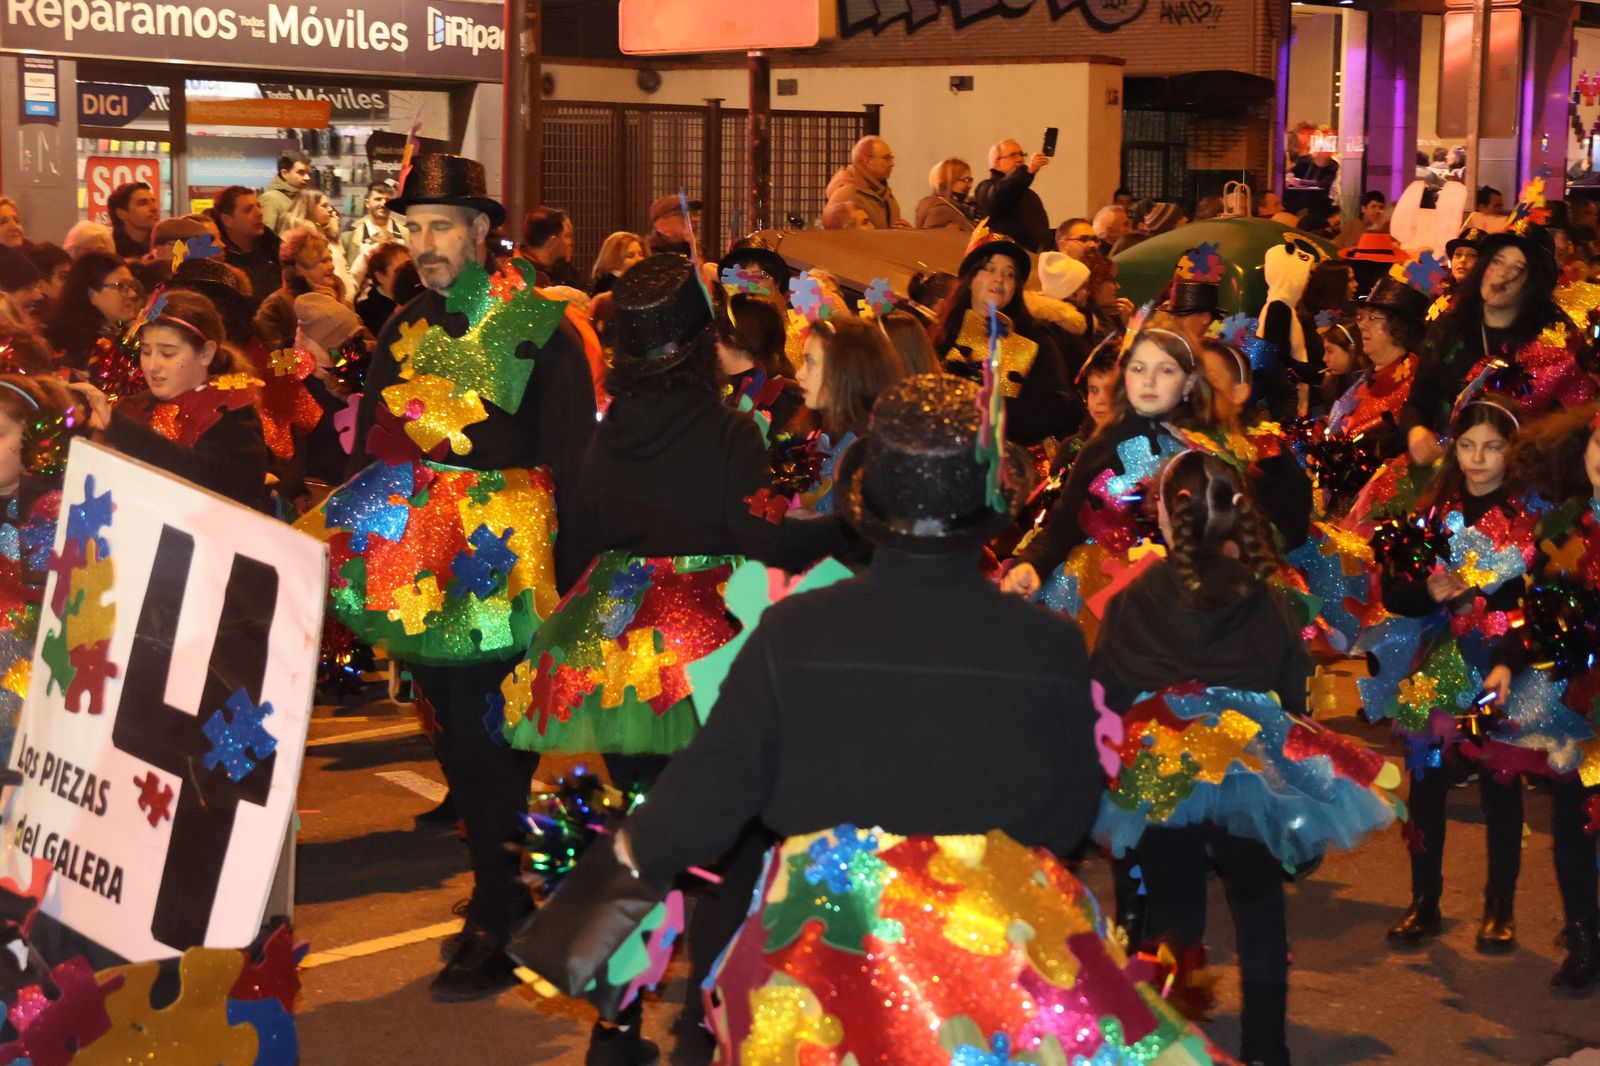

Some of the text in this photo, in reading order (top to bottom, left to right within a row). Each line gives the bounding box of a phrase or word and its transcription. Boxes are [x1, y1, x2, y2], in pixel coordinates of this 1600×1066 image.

[7, 0, 238, 41] Reparamos
[239, 15, 265, 27] Todos
[251, 27, 265, 39] los
[268, 3, 409, 52] Móviles
[82, 93, 128, 116] DIGI
[17, 734, 111, 817] Los PIEZAS
[14, 814, 124, 904] del GALERA
